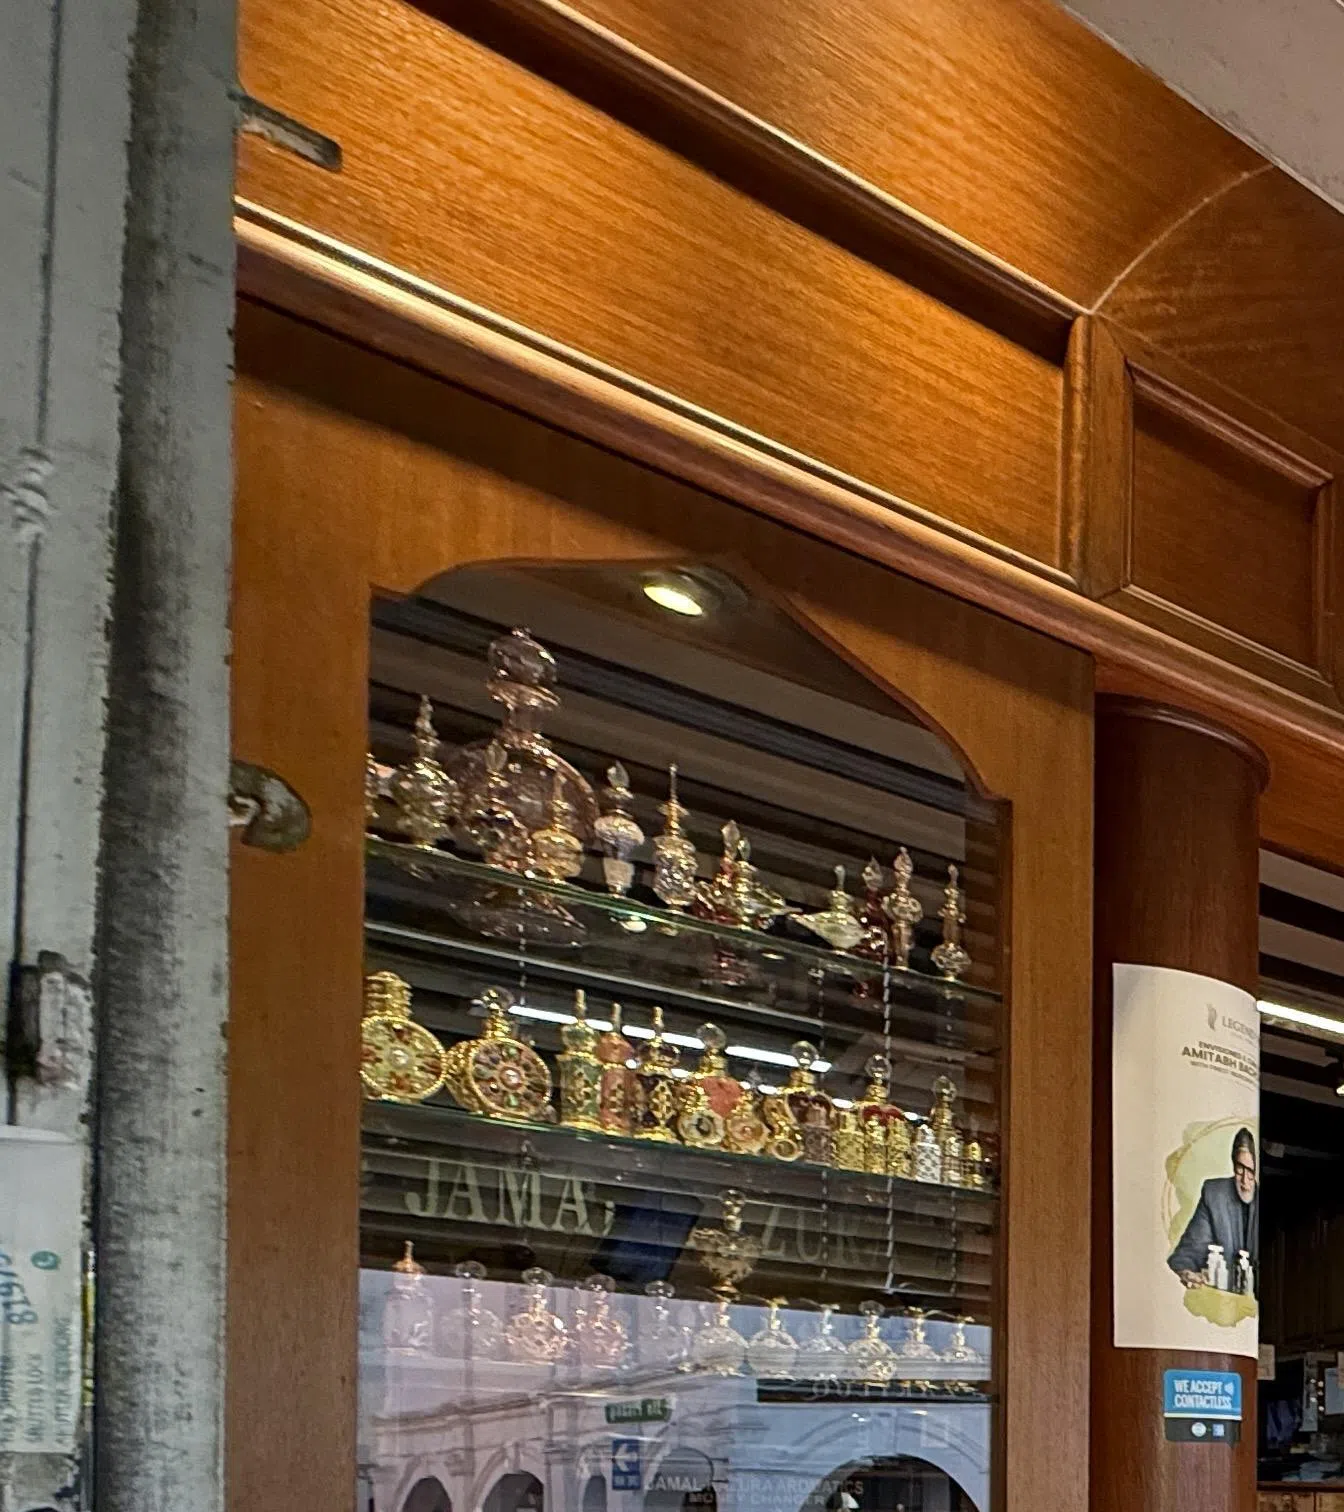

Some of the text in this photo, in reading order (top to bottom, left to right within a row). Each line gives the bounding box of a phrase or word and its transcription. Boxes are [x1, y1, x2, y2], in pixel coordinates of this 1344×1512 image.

[1182, 1046, 1238, 1069] AMITABH
[404, 1158, 616, 1238] JAMA
[1174, 1380, 1222, 1394] WE ACCEPT
[1174, 1394, 1232, 1410] CONTACTLESS
